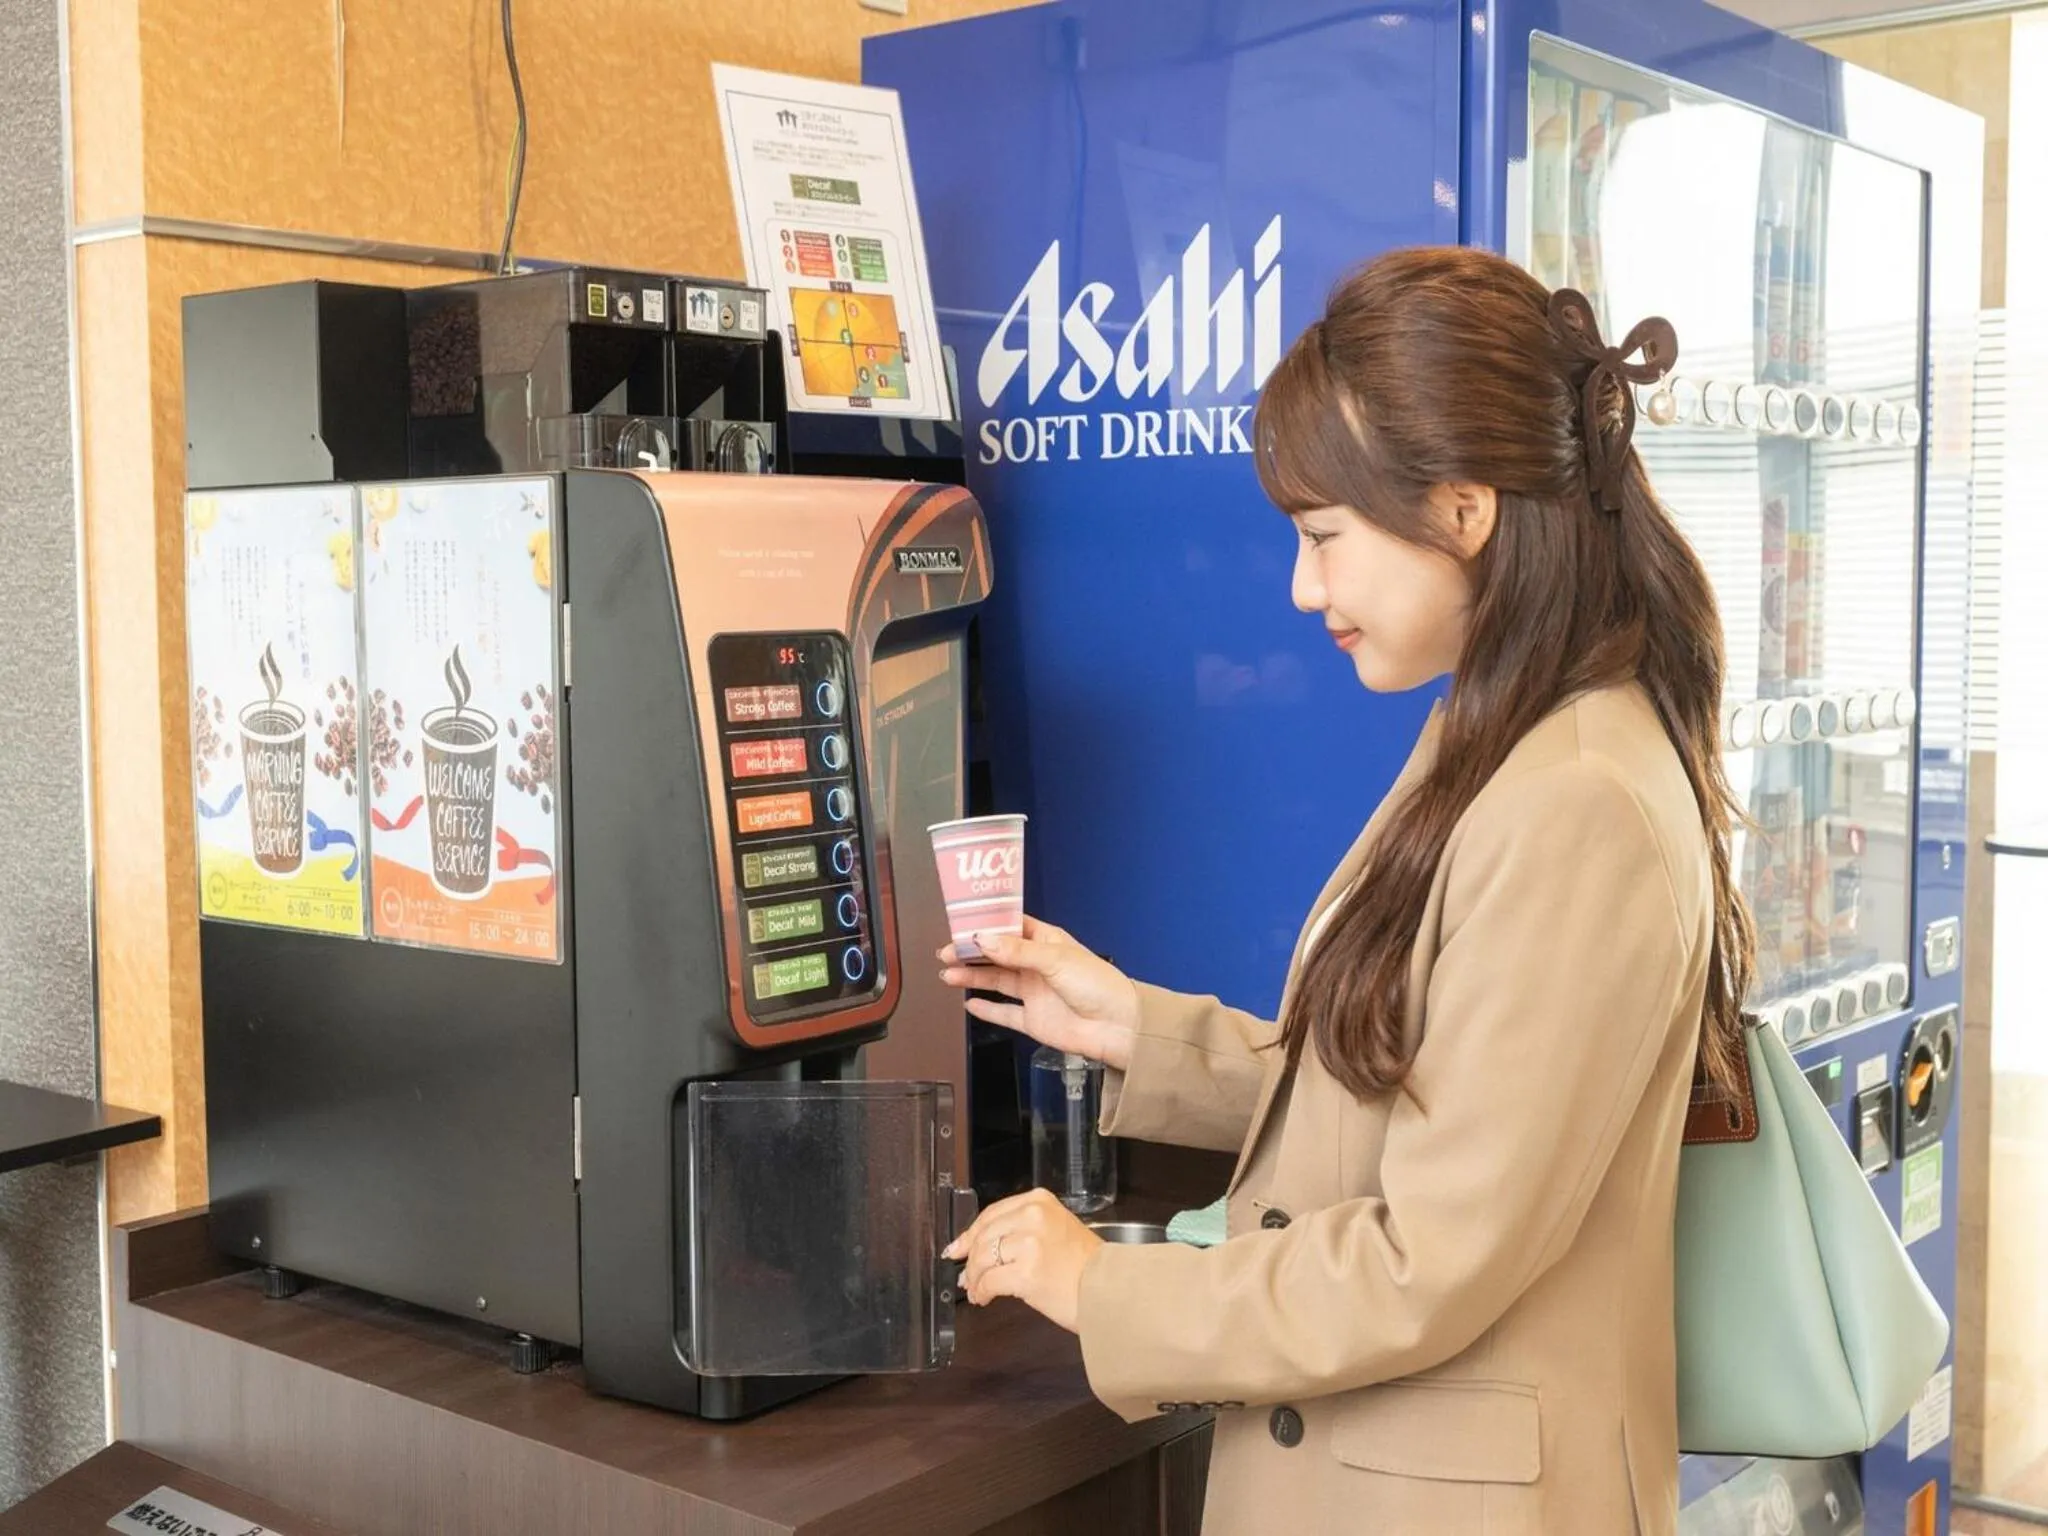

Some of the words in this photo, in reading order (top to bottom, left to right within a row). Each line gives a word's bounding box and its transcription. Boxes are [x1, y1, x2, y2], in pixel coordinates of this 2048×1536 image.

[978, 214, 1281, 408] Asahi
[979, 414, 1088, 465] SOFT
[900, 551, 957, 568] BONMAC
[735, 702, 766, 716] Strong
[767, 700, 797, 712] Coffee
[246, 749, 302, 788] MORNING
[746, 758, 766, 770] Mild
[767, 756, 796, 769] Coffee
[428, 760, 493, 801] WELCOME
[256, 789, 298, 823] COFFEE
[436, 801, 486, 840] COFFEE
[256, 826, 299, 860] SERVICE
[435, 841, 486, 879] SERVICE
[763, 864, 786, 878] Decaf
[788, 861, 816, 875] Strong
[769, 918, 794, 933] Decaf
[798, 914, 817, 928] Mild
[775, 972, 800, 987] Decaf
[804, 966, 826, 983] Light
[125, 1503, 218, 1536] 燃えない
